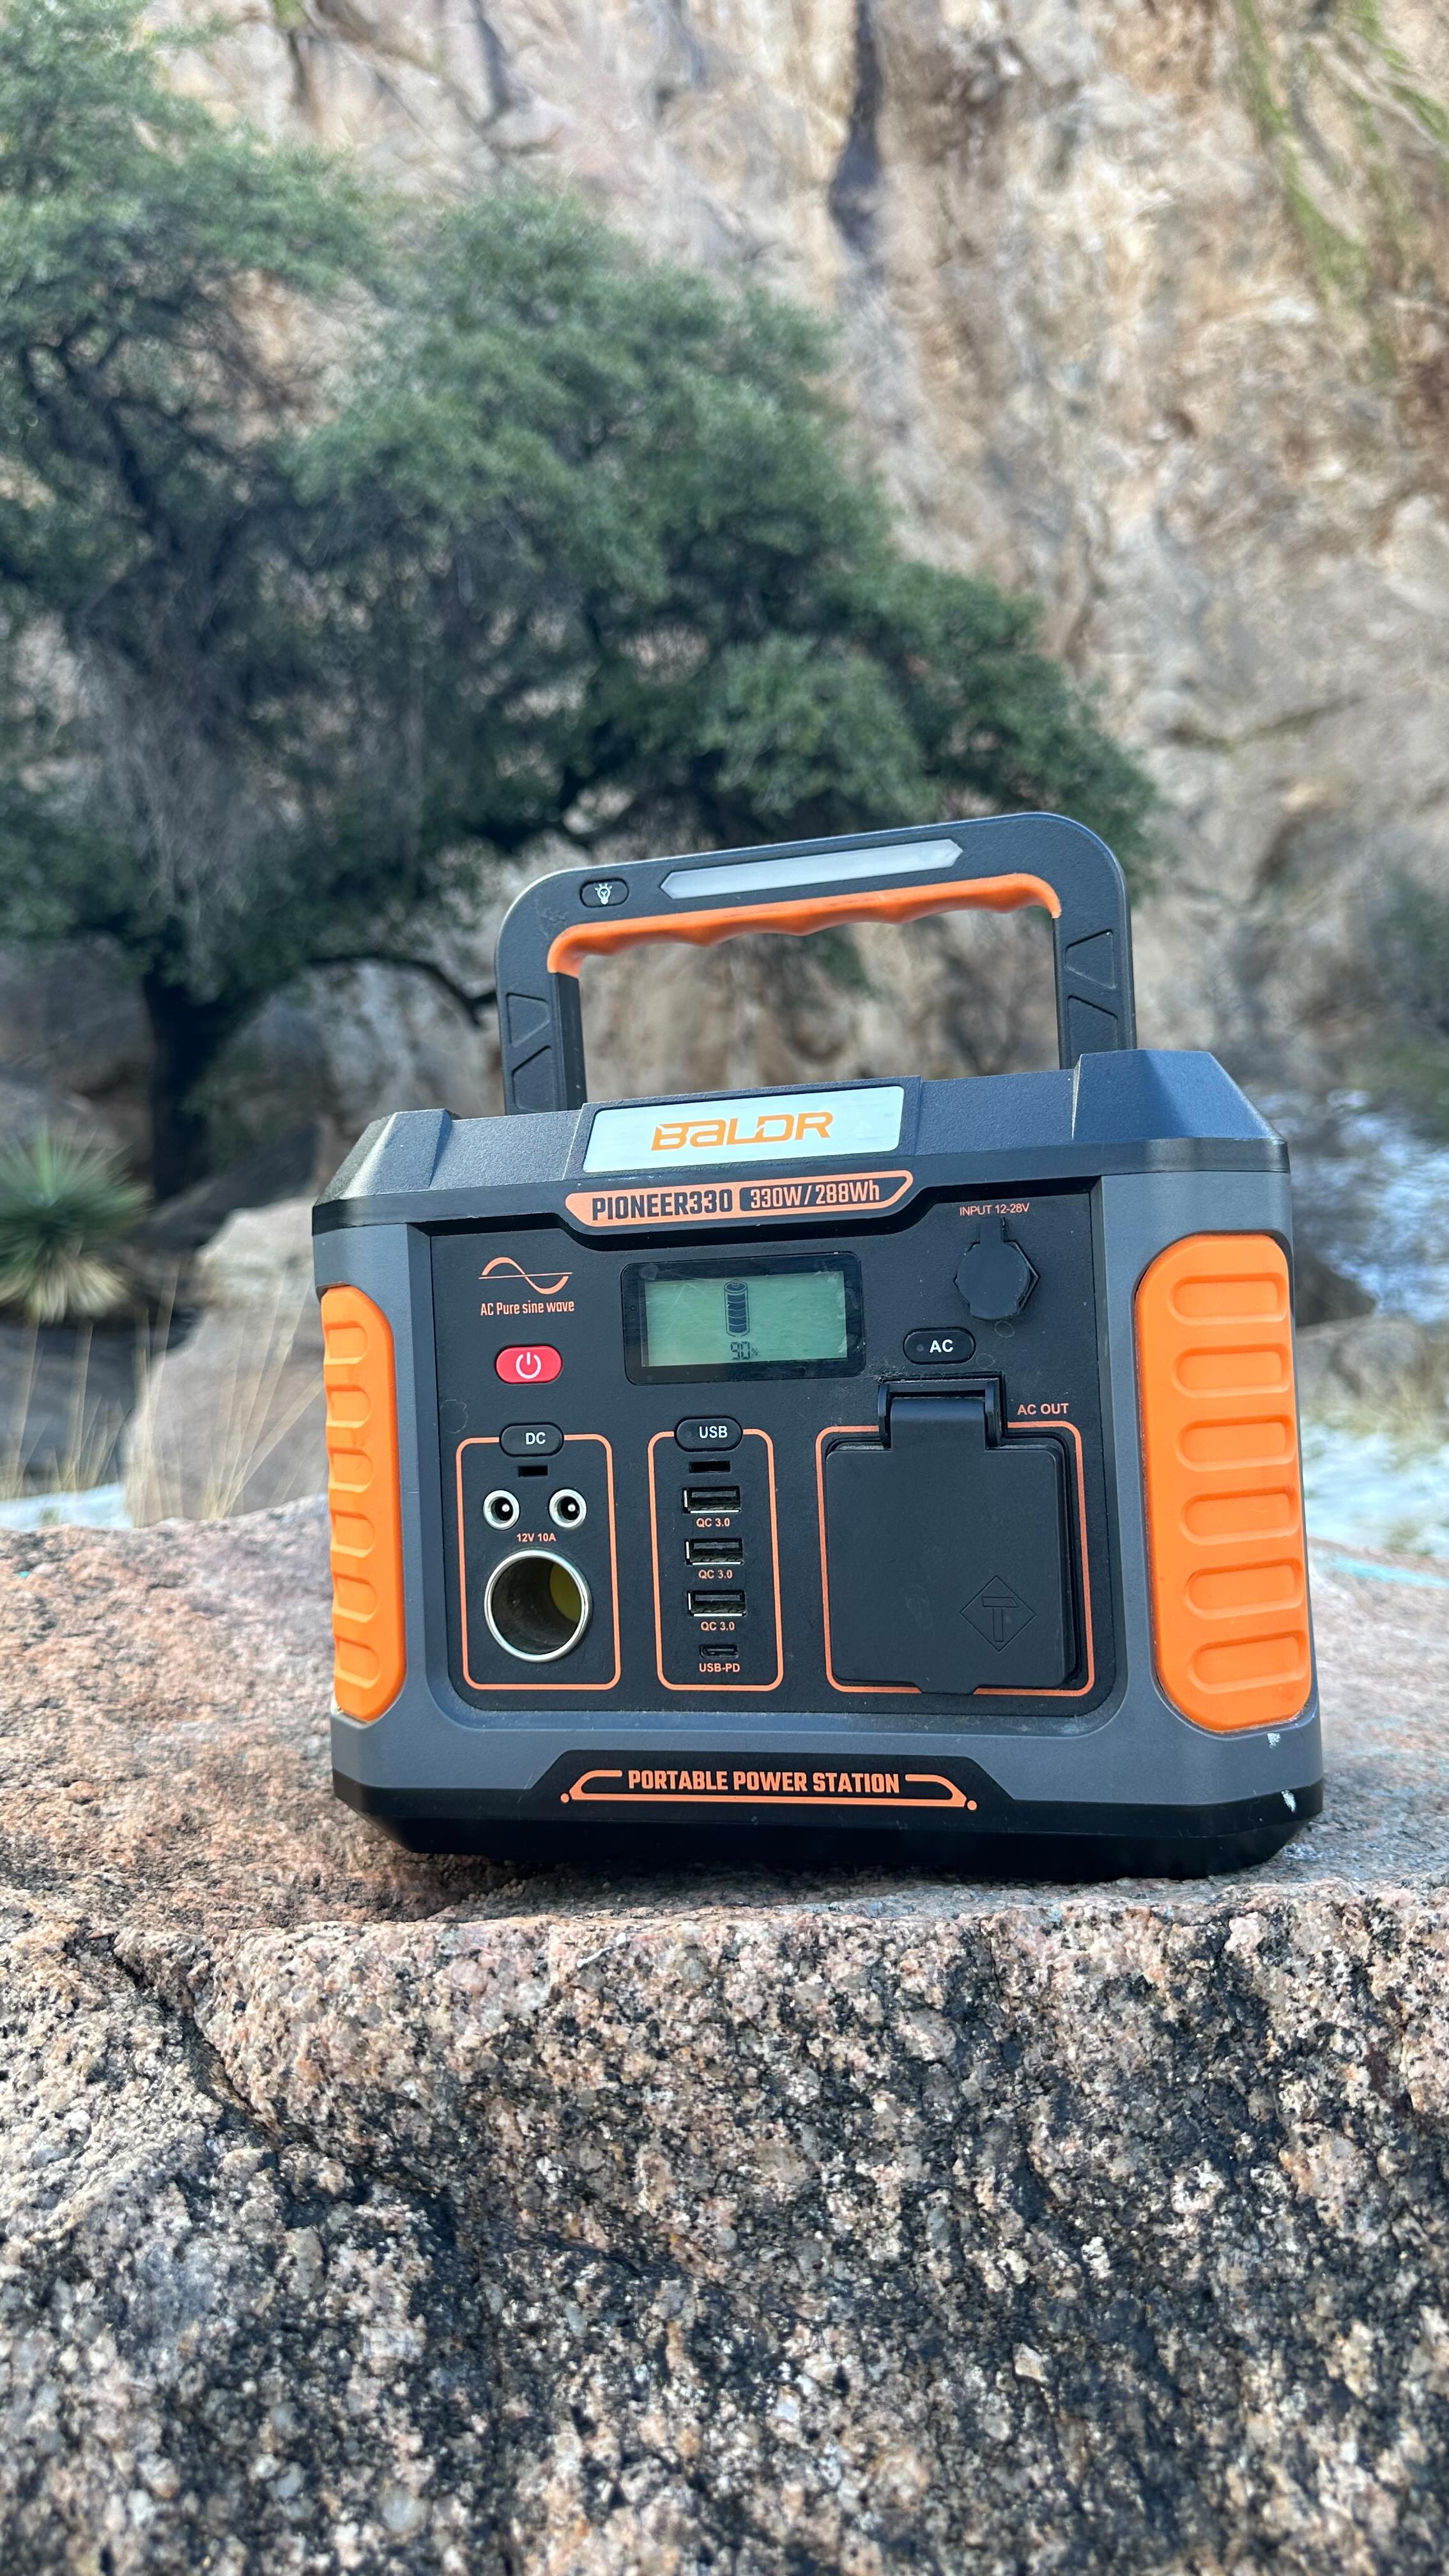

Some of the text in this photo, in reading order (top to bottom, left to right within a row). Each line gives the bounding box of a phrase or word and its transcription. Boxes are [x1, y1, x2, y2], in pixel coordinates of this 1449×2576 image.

[592, 1189, 732, 1221] PIONEER330
[960, 1202, 1030, 1216] INPUT 12-28V
[480, 1300, 574, 1315] AC Pure sine wave
[730, 1341, 758, 1360] 90%
[930, 1339, 953, 1353] AC
[1017, 1403, 1069, 1415] AC OUT
[525, 1432, 546, 1445] DC
[699, 1425, 728, 1439] USB
[696, 1517, 730, 1528] QC 3.0
[516, 1533, 556, 1542] 12V 10A
[698, 1569, 733, 1579] QC 3.0
[700, 1621, 735, 1631] QC 3.0
[699, 1662, 740, 1673] USB-PD
[628, 1770, 900, 1794] PORTABLE POWER STATION
